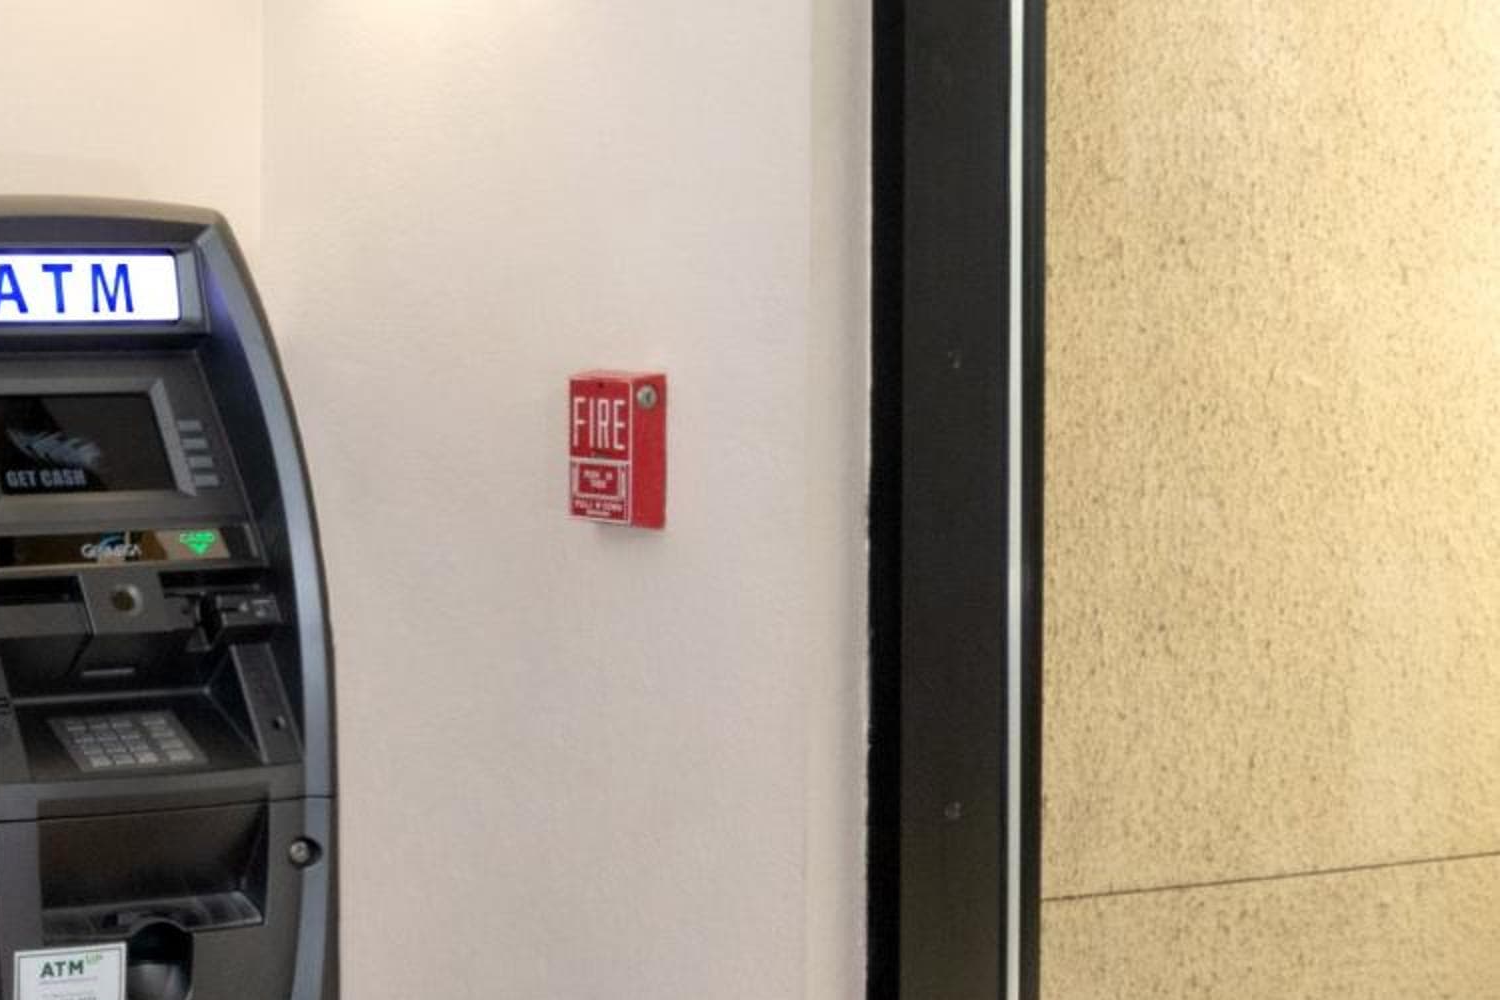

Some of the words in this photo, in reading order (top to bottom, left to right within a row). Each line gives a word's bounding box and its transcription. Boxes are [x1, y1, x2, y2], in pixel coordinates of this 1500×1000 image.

[573, 396, 626, 451] FIRE
[5, 469, 37, 488] GET
[39, 468, 87, 488] CASH
[40, 960, 85, 978] ATM
